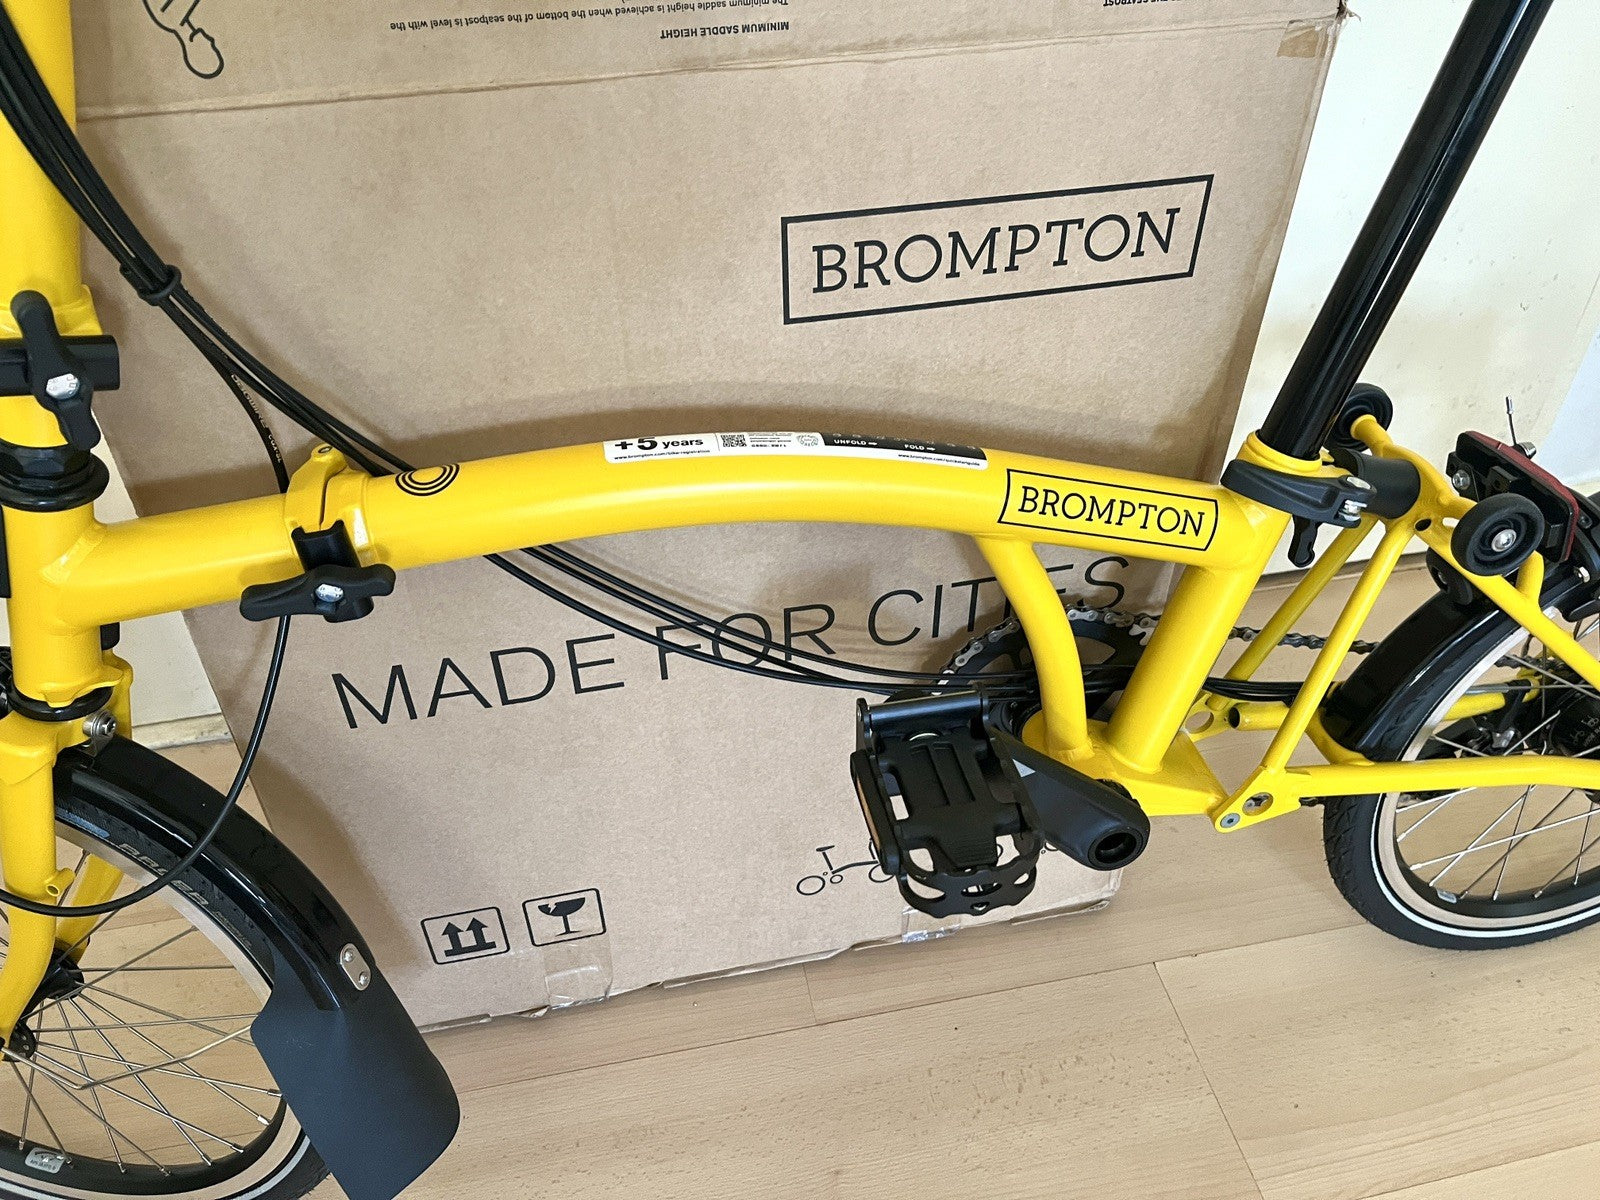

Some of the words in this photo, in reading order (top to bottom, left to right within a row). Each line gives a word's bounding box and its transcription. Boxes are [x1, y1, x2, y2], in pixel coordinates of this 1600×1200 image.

[657, 5, 666, 14] is
[667, 3, 695, 15] height
[698, 1, 727, 11] saddle
[729, 0, 770, 8] minimum
[536, 11, 569, 21] bottom
[571, 9, 586, 19] the
[588, 8, 613, 18] when
[615, 6, 655, 17] achieved
[454, 17, 463, 27] is
[465, 15, 505, 27] seatpost
[507, 14, 523, 24] the
[525, 13, 534, 22] of
[390, 21, 406, 31] the
[408, 20, 428, 31] with
[430, 18, 452, 29] level
[742, 21, 790, 34] MINIMUM
[660, 28, 698, 39] HEIGHT
[700, 25, 739, 37] SADDLE
[812, 207, 1181, 293] BROMPTON
[662, 438, 704, 449] years
[1018, 486, 1205, 537] BROMPTON
[332, 633, 625, 729] MADE
[655, 604, 836, 680] FOR
[868, 555, 1129, 646] CITS
